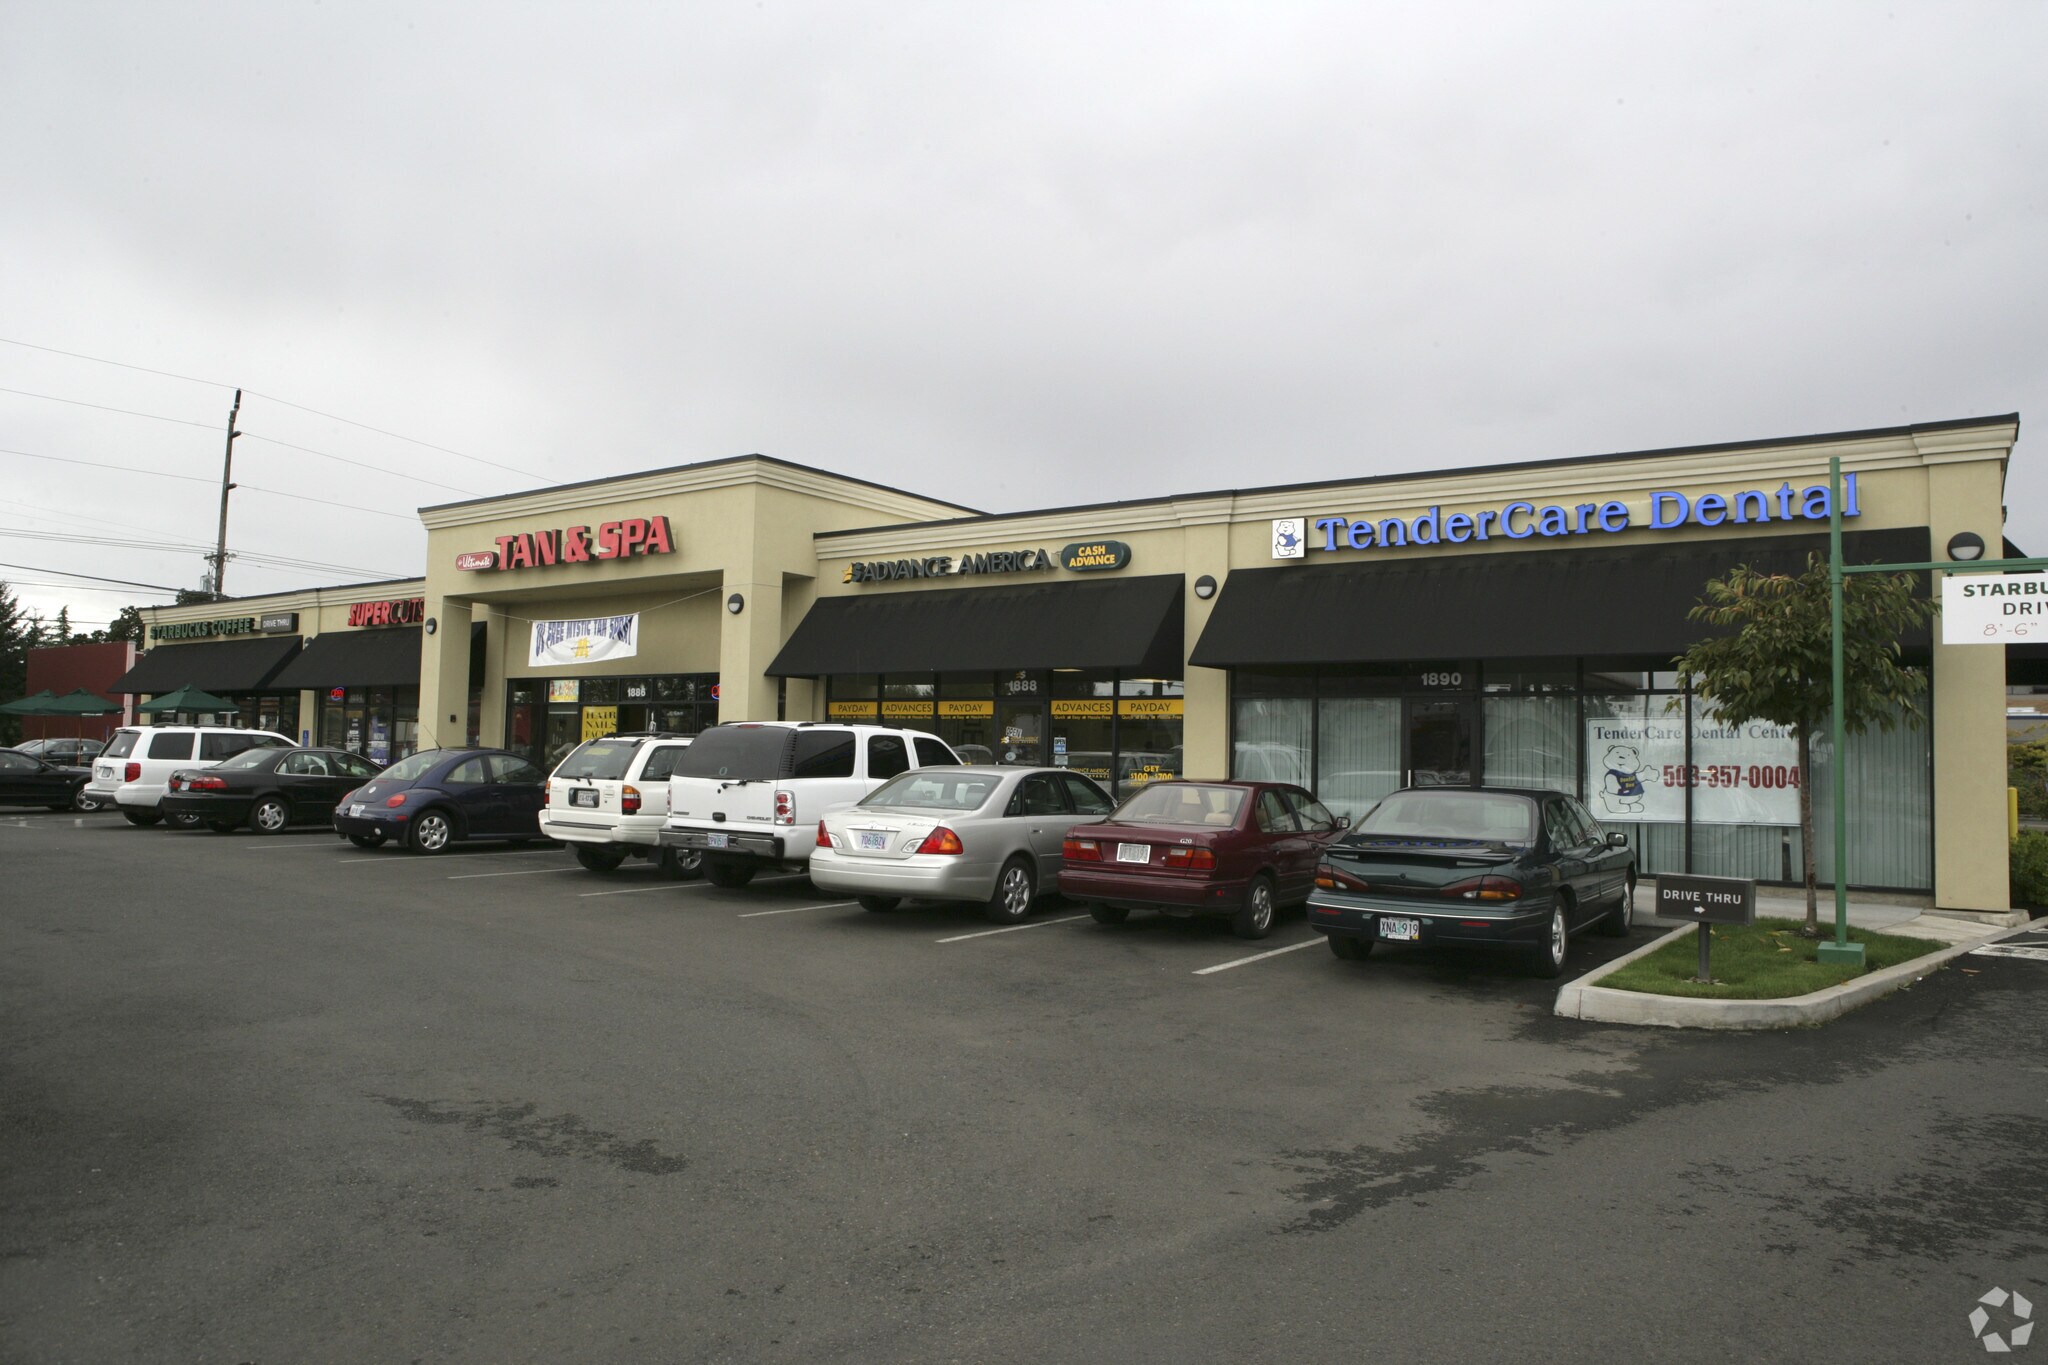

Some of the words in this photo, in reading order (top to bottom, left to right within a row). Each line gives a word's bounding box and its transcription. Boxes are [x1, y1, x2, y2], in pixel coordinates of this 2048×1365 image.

[1315, 500, 1628, 552] TenderCare
[1649, 473, 1861, 531] Dental
[495, 529, 559, 571] TAN
[564, 526, 590, 563] &
[599, 516, 671, 560] SPA
[1078, 545, 1106, 557] CASH
[862, 557, 948, 581] ADVANCE
[957, 549, 1048, 576] AMERICA
[1069, 554, 1116, 568] ADVANCE
[2002, 601, 2048, 616] DRI
[150, 621, 208, 640] STARBUCKS
[211, 617, 251, 636] COFFEE
[1009, 680, 1038, 692] 1888
[1421, 672, 1462, 686] 1890
[838, 704, 869, 712] PAYDAY
[884, 703, 932, 713] ADVANCES
[948, 703, 984, 712] PAYDAY
[1054, 702, 1111, 712] ADVANCES
[1130, 702, 1171, 712] PAYDAY
[1594, 725, 1682, 740] TenderCare
[1143, 765, 1160, 773] GET
[1130, 772, 1149, 781] $100
[1663, 889, 1700, 902] DRIVE
[1706, 892, 1742, 905] THRU
[1381, 920, 1397, 933] XNA
[1402, 922, 1418, 935] 919
